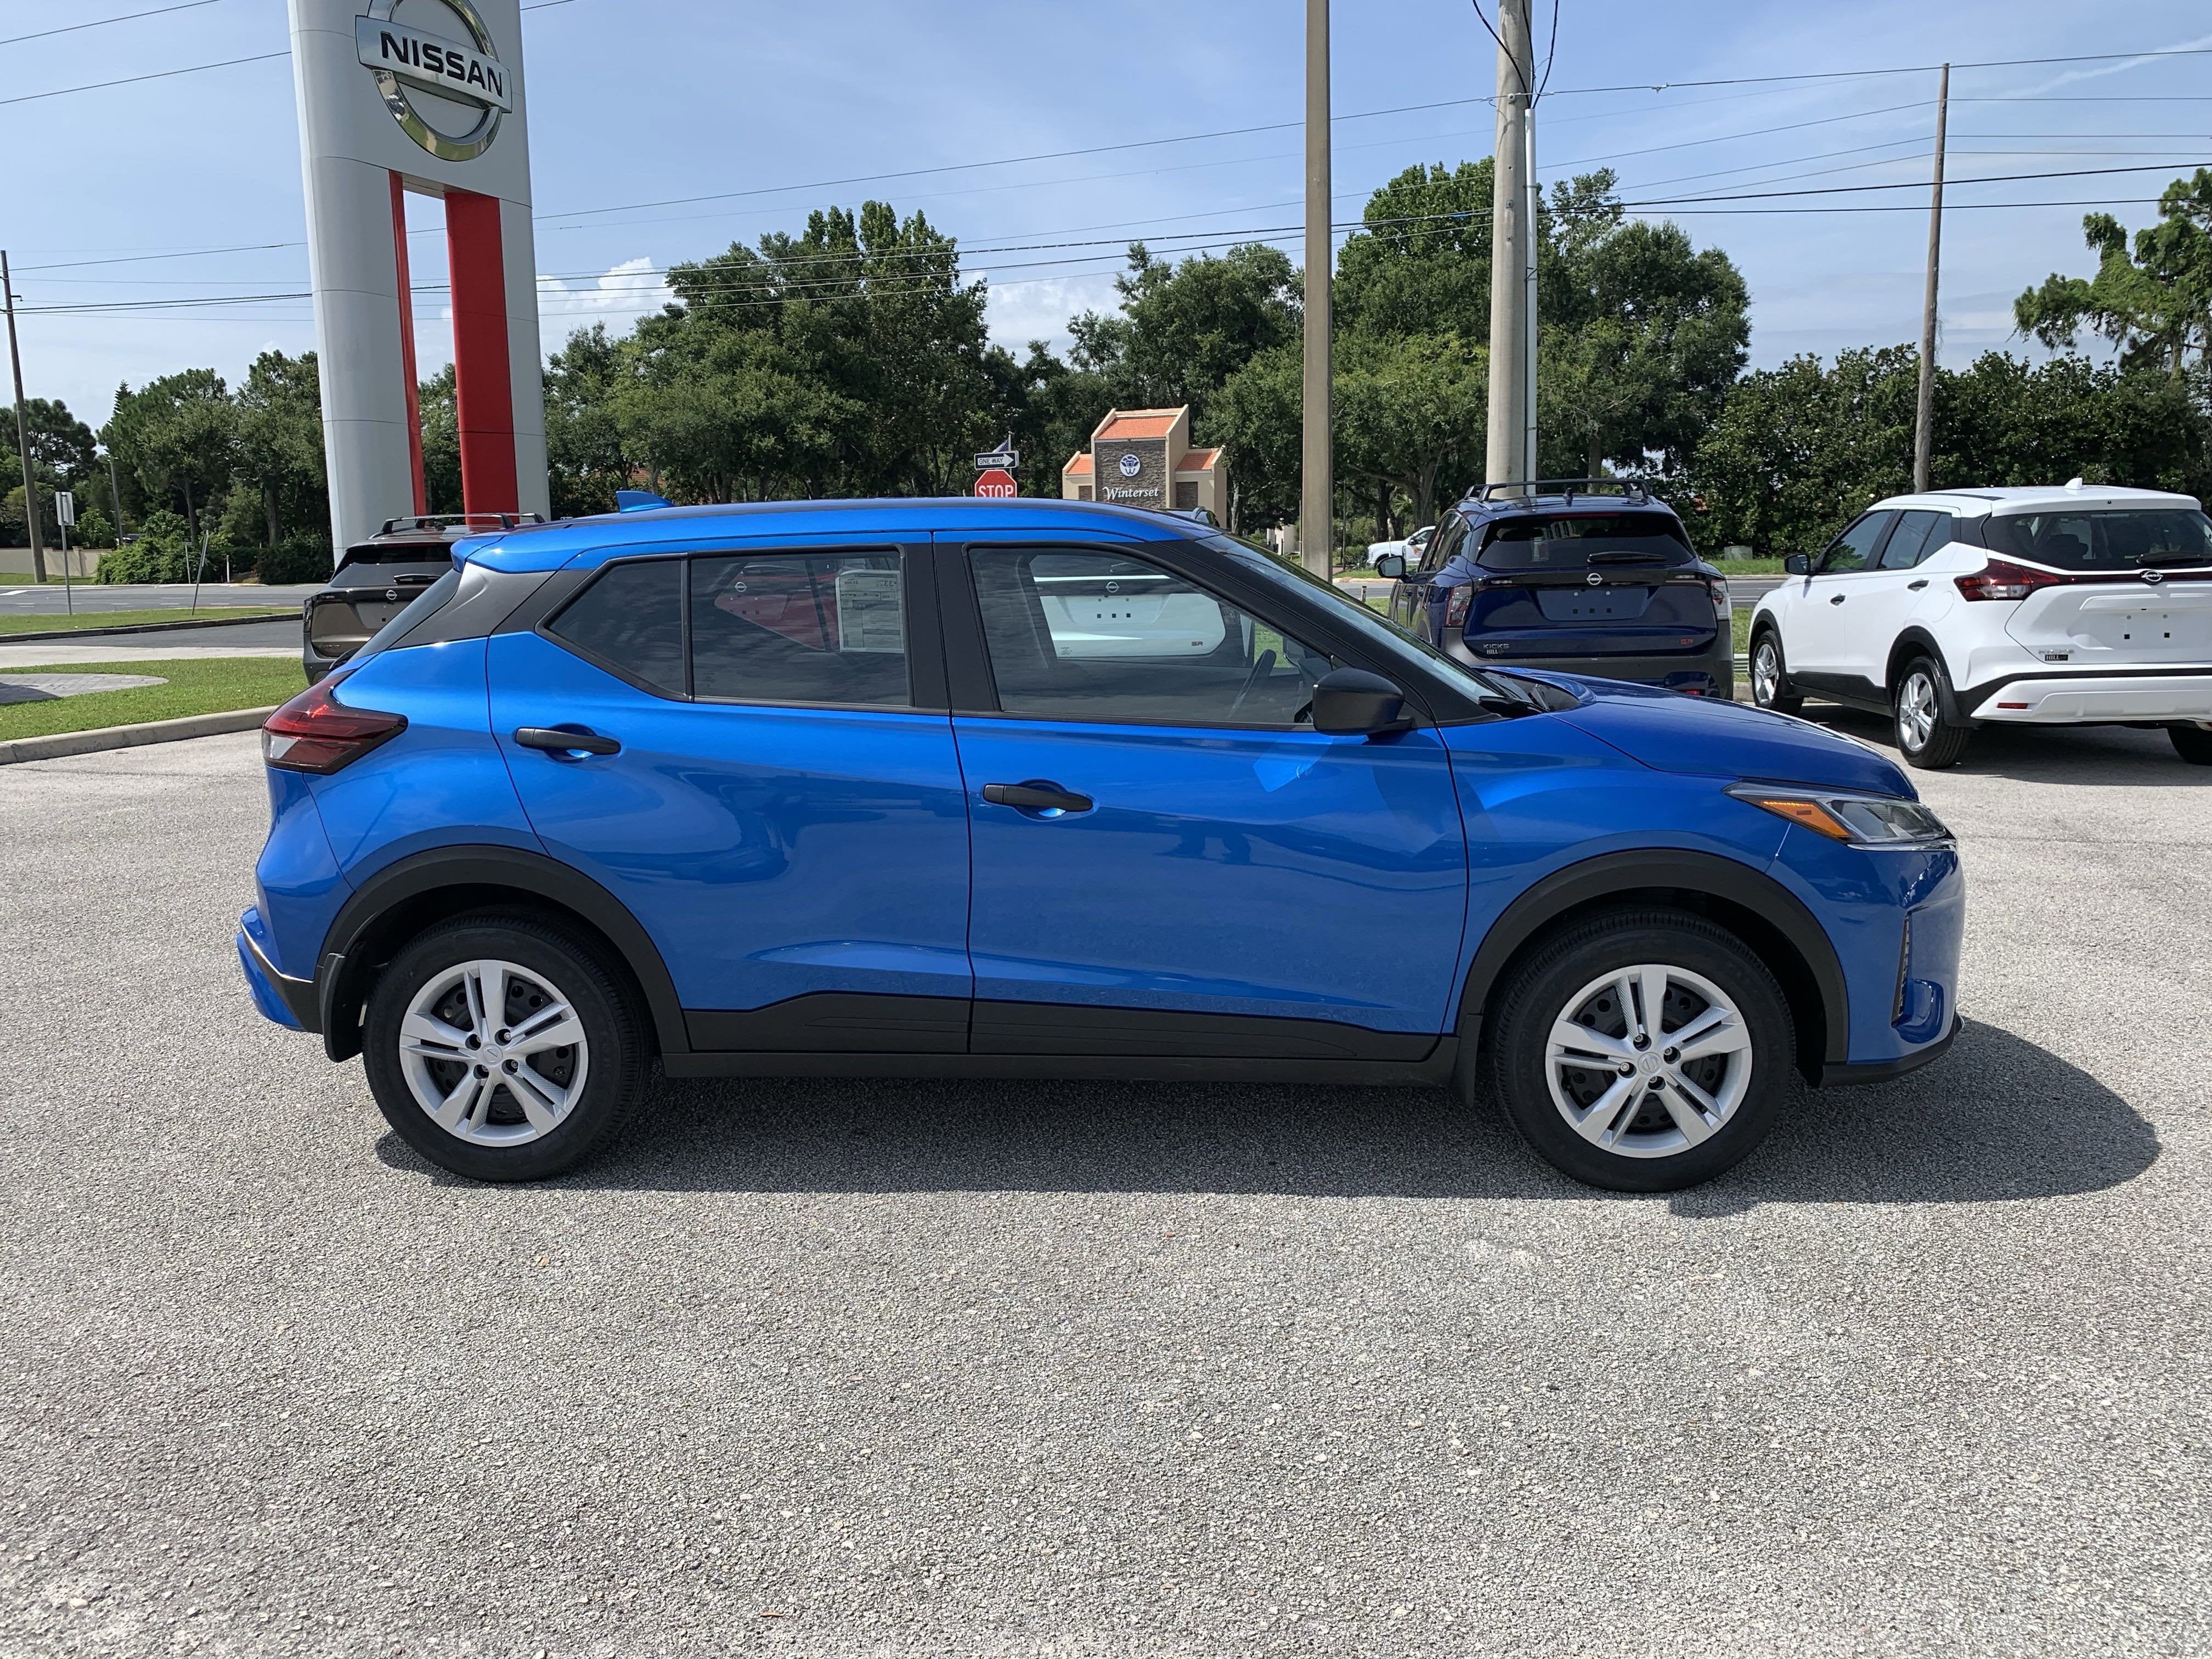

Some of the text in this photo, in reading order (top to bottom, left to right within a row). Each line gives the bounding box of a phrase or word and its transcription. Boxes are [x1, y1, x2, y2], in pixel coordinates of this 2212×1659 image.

[380, 30, 504, 99] NISSAN
[978, 484, 1014, 498] STOP
[1102, 487, 1159, 500] Winterset
